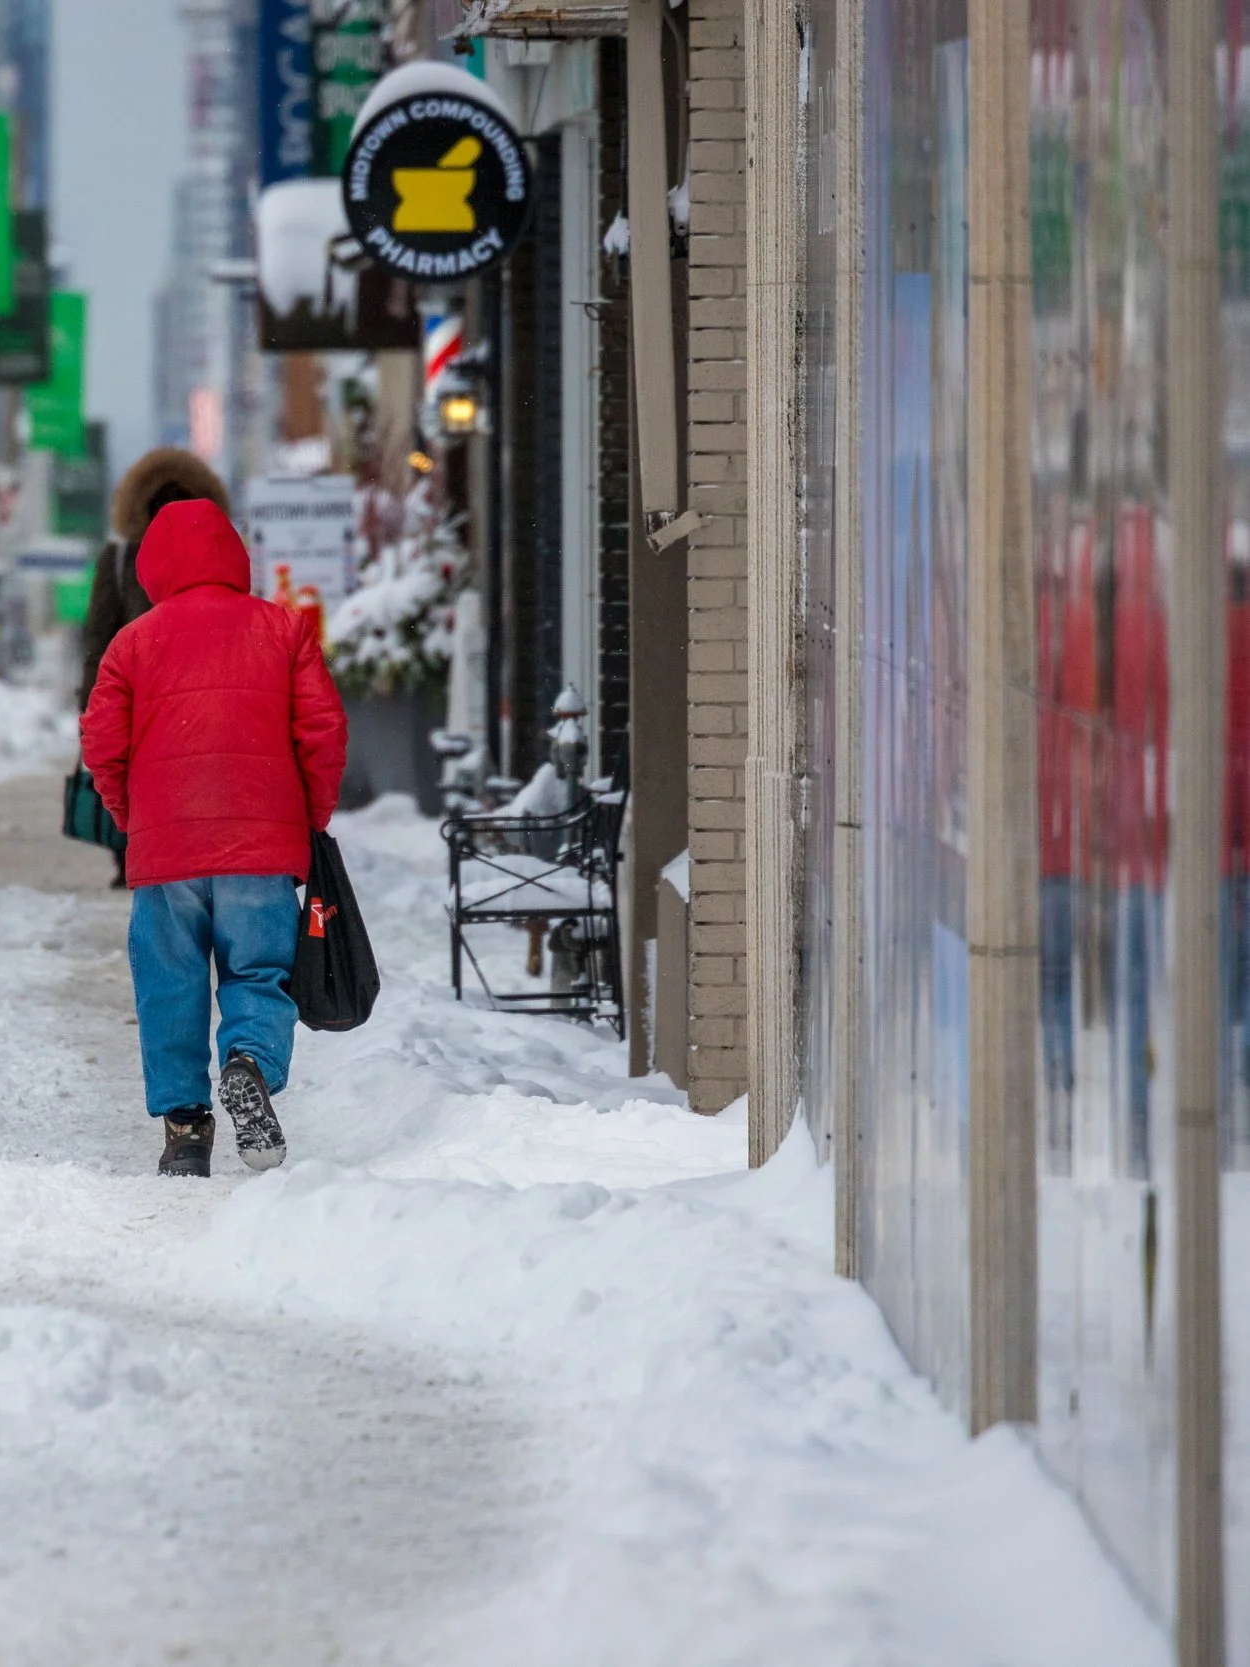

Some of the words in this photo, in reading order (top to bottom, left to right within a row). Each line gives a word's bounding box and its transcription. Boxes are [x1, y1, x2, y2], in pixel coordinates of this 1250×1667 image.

[351, 106, 410, 201] MIDTOWN
[408, 98, 526, 202] COMPOUNDING
[365, 223, 504, 276] PHARMACY
